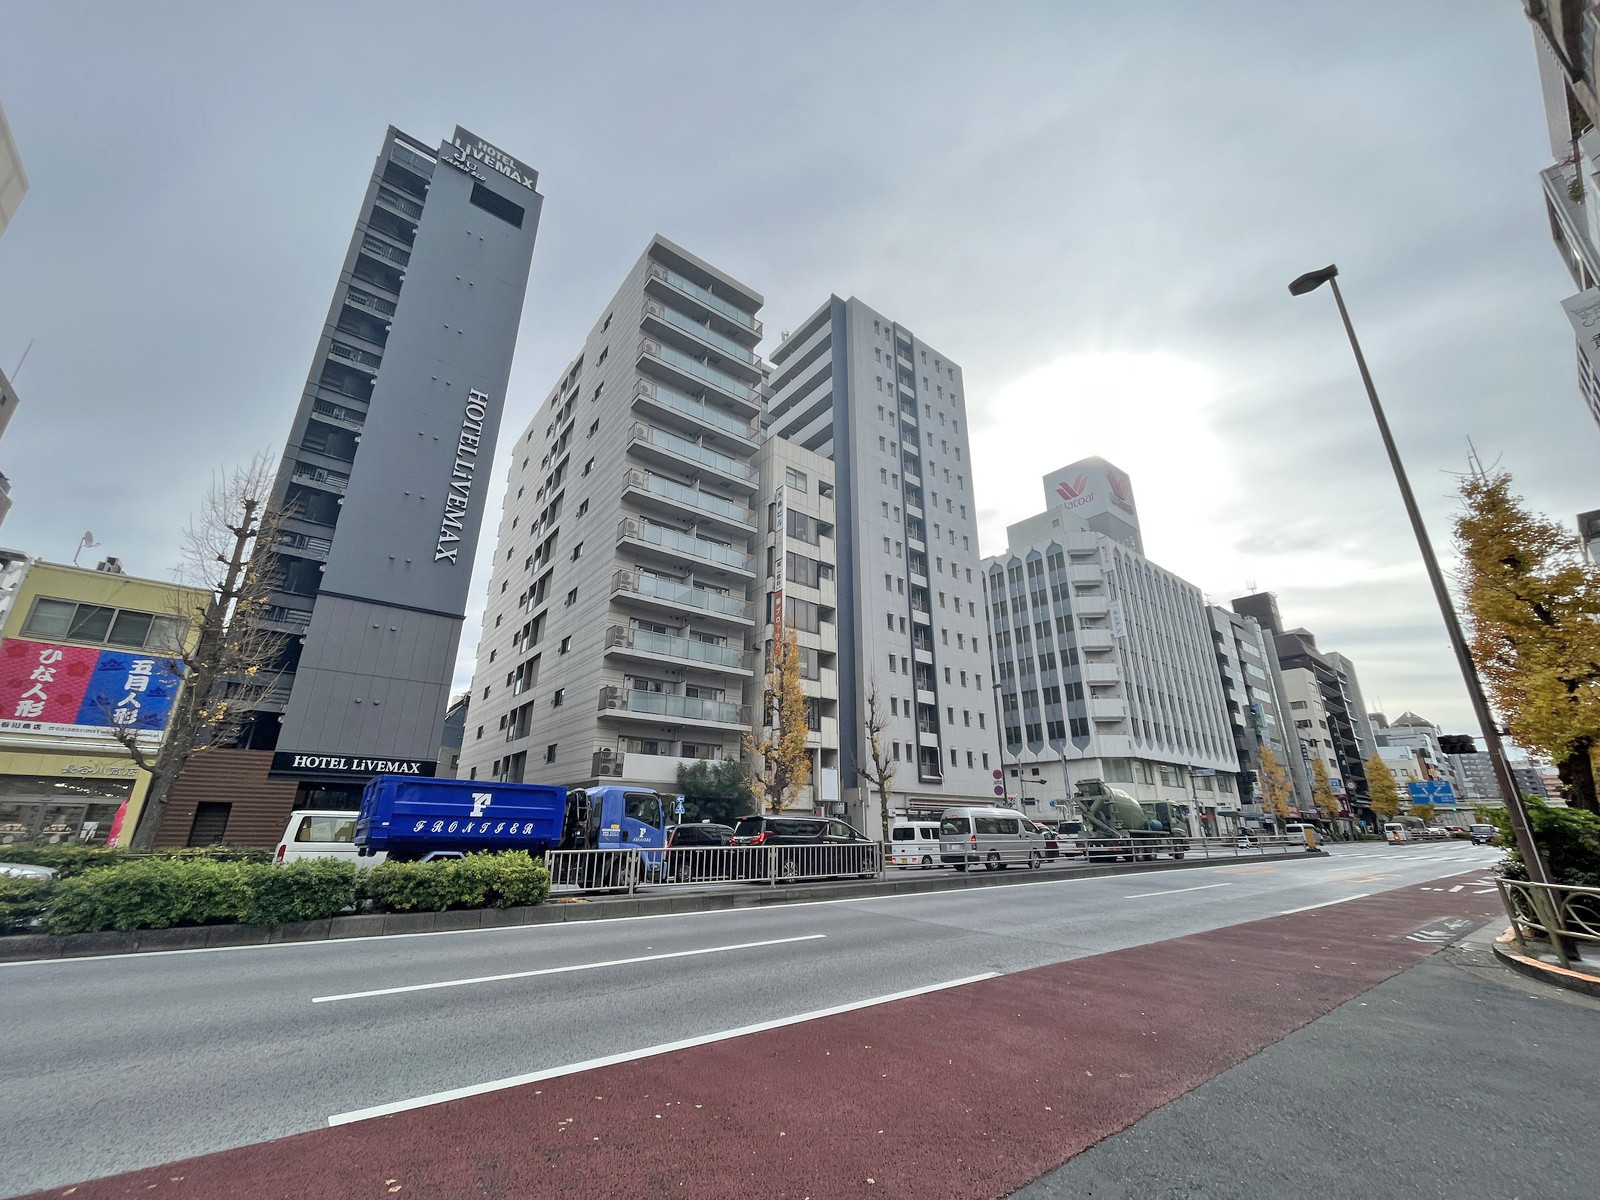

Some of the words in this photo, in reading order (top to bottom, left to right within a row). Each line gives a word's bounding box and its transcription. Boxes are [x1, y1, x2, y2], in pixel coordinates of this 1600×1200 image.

[441, 155, 470, 172] JAPAN
[470, 171, 486, 181] BLD
[478, 141, 516, 169] HOTEL
[457, 387, 489, 457] HOTEL
[434, 457, 475, 565] LiVEMAX
[1056, 492, 1095, 510] acoal
[15, 648, 62, 718] ひな人形
[112, 659, 155, 725] 五月人形
[61, 763, 139, 776] 長谷川商店
[292, 755, 349, 770] HOTEL
[351, 758, 421, 774] LiVEMAX
[413, 820, 534, 835] FRONTIER
